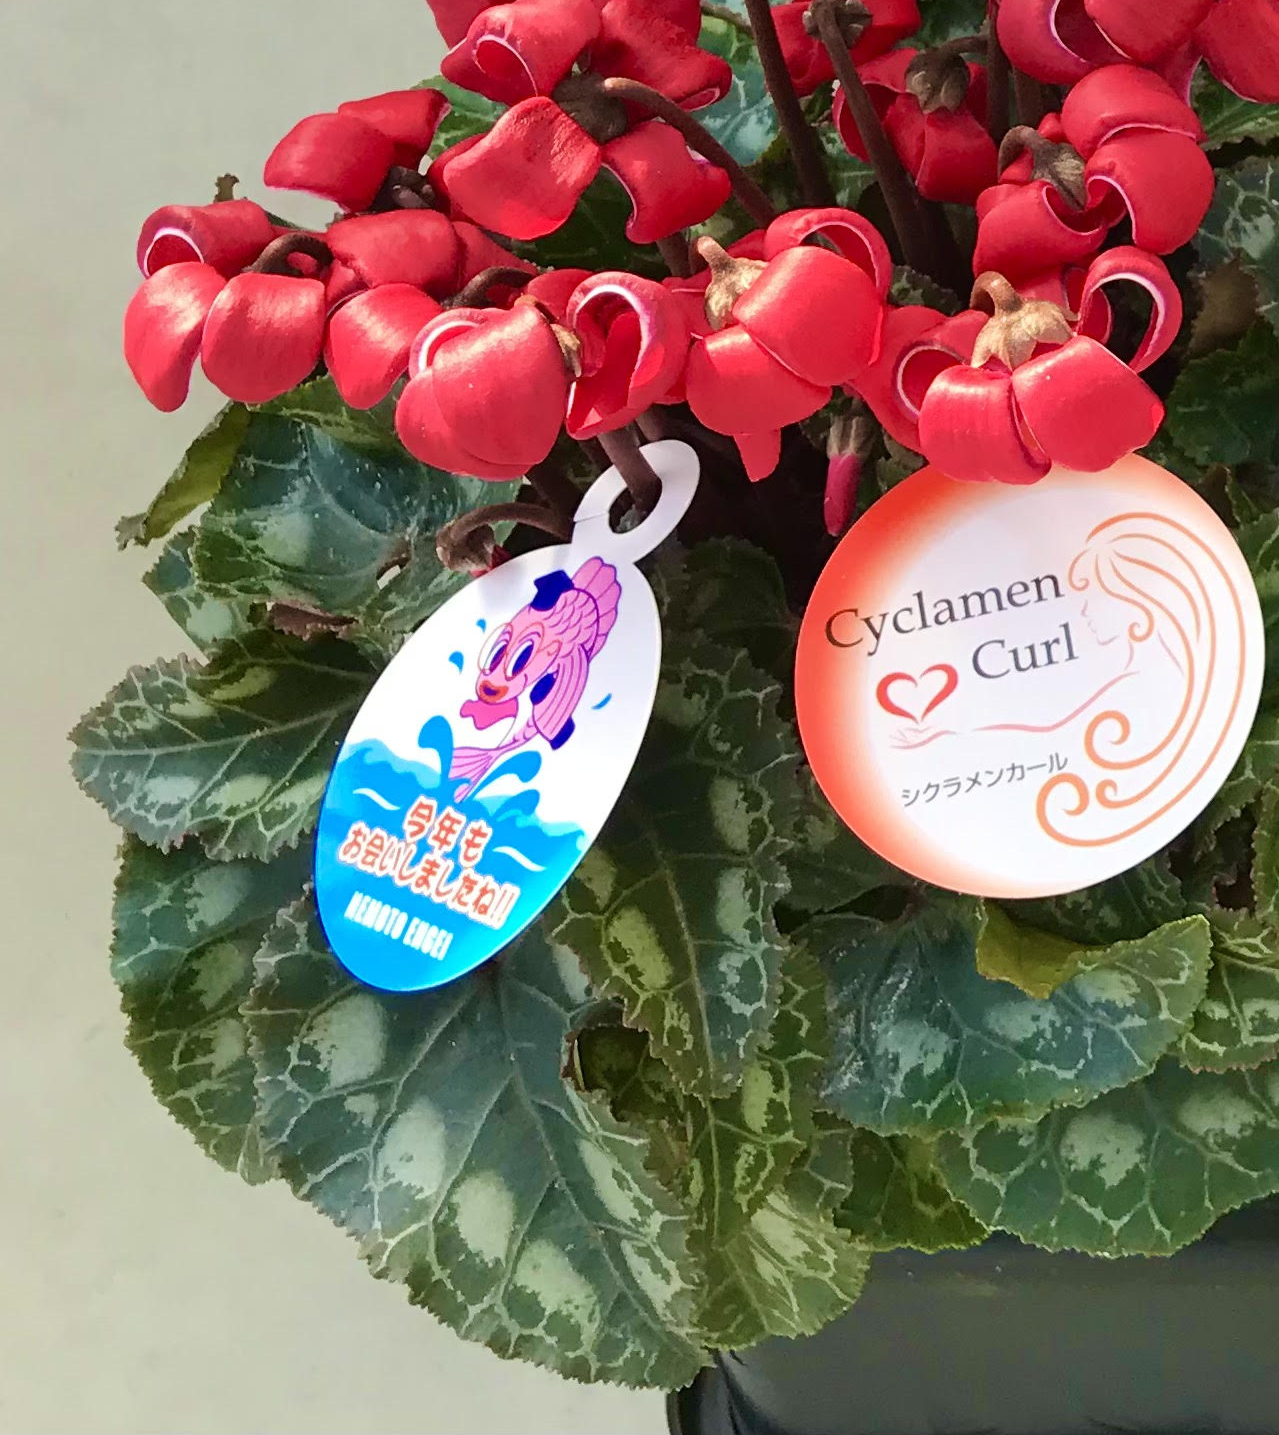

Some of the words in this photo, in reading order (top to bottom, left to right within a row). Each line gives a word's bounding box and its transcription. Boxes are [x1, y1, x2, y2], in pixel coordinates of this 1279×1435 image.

[825, 572, 1064, 657] Cyclamen
[971, 622, 1079, 680] Curl
[901, 752, 1069, 807] シクラメンカール
[402, 795, 493, 867] 今年も
[344, 891, 406, 940] NEMOTO
[403, 917, 454, 961] ENGEI
